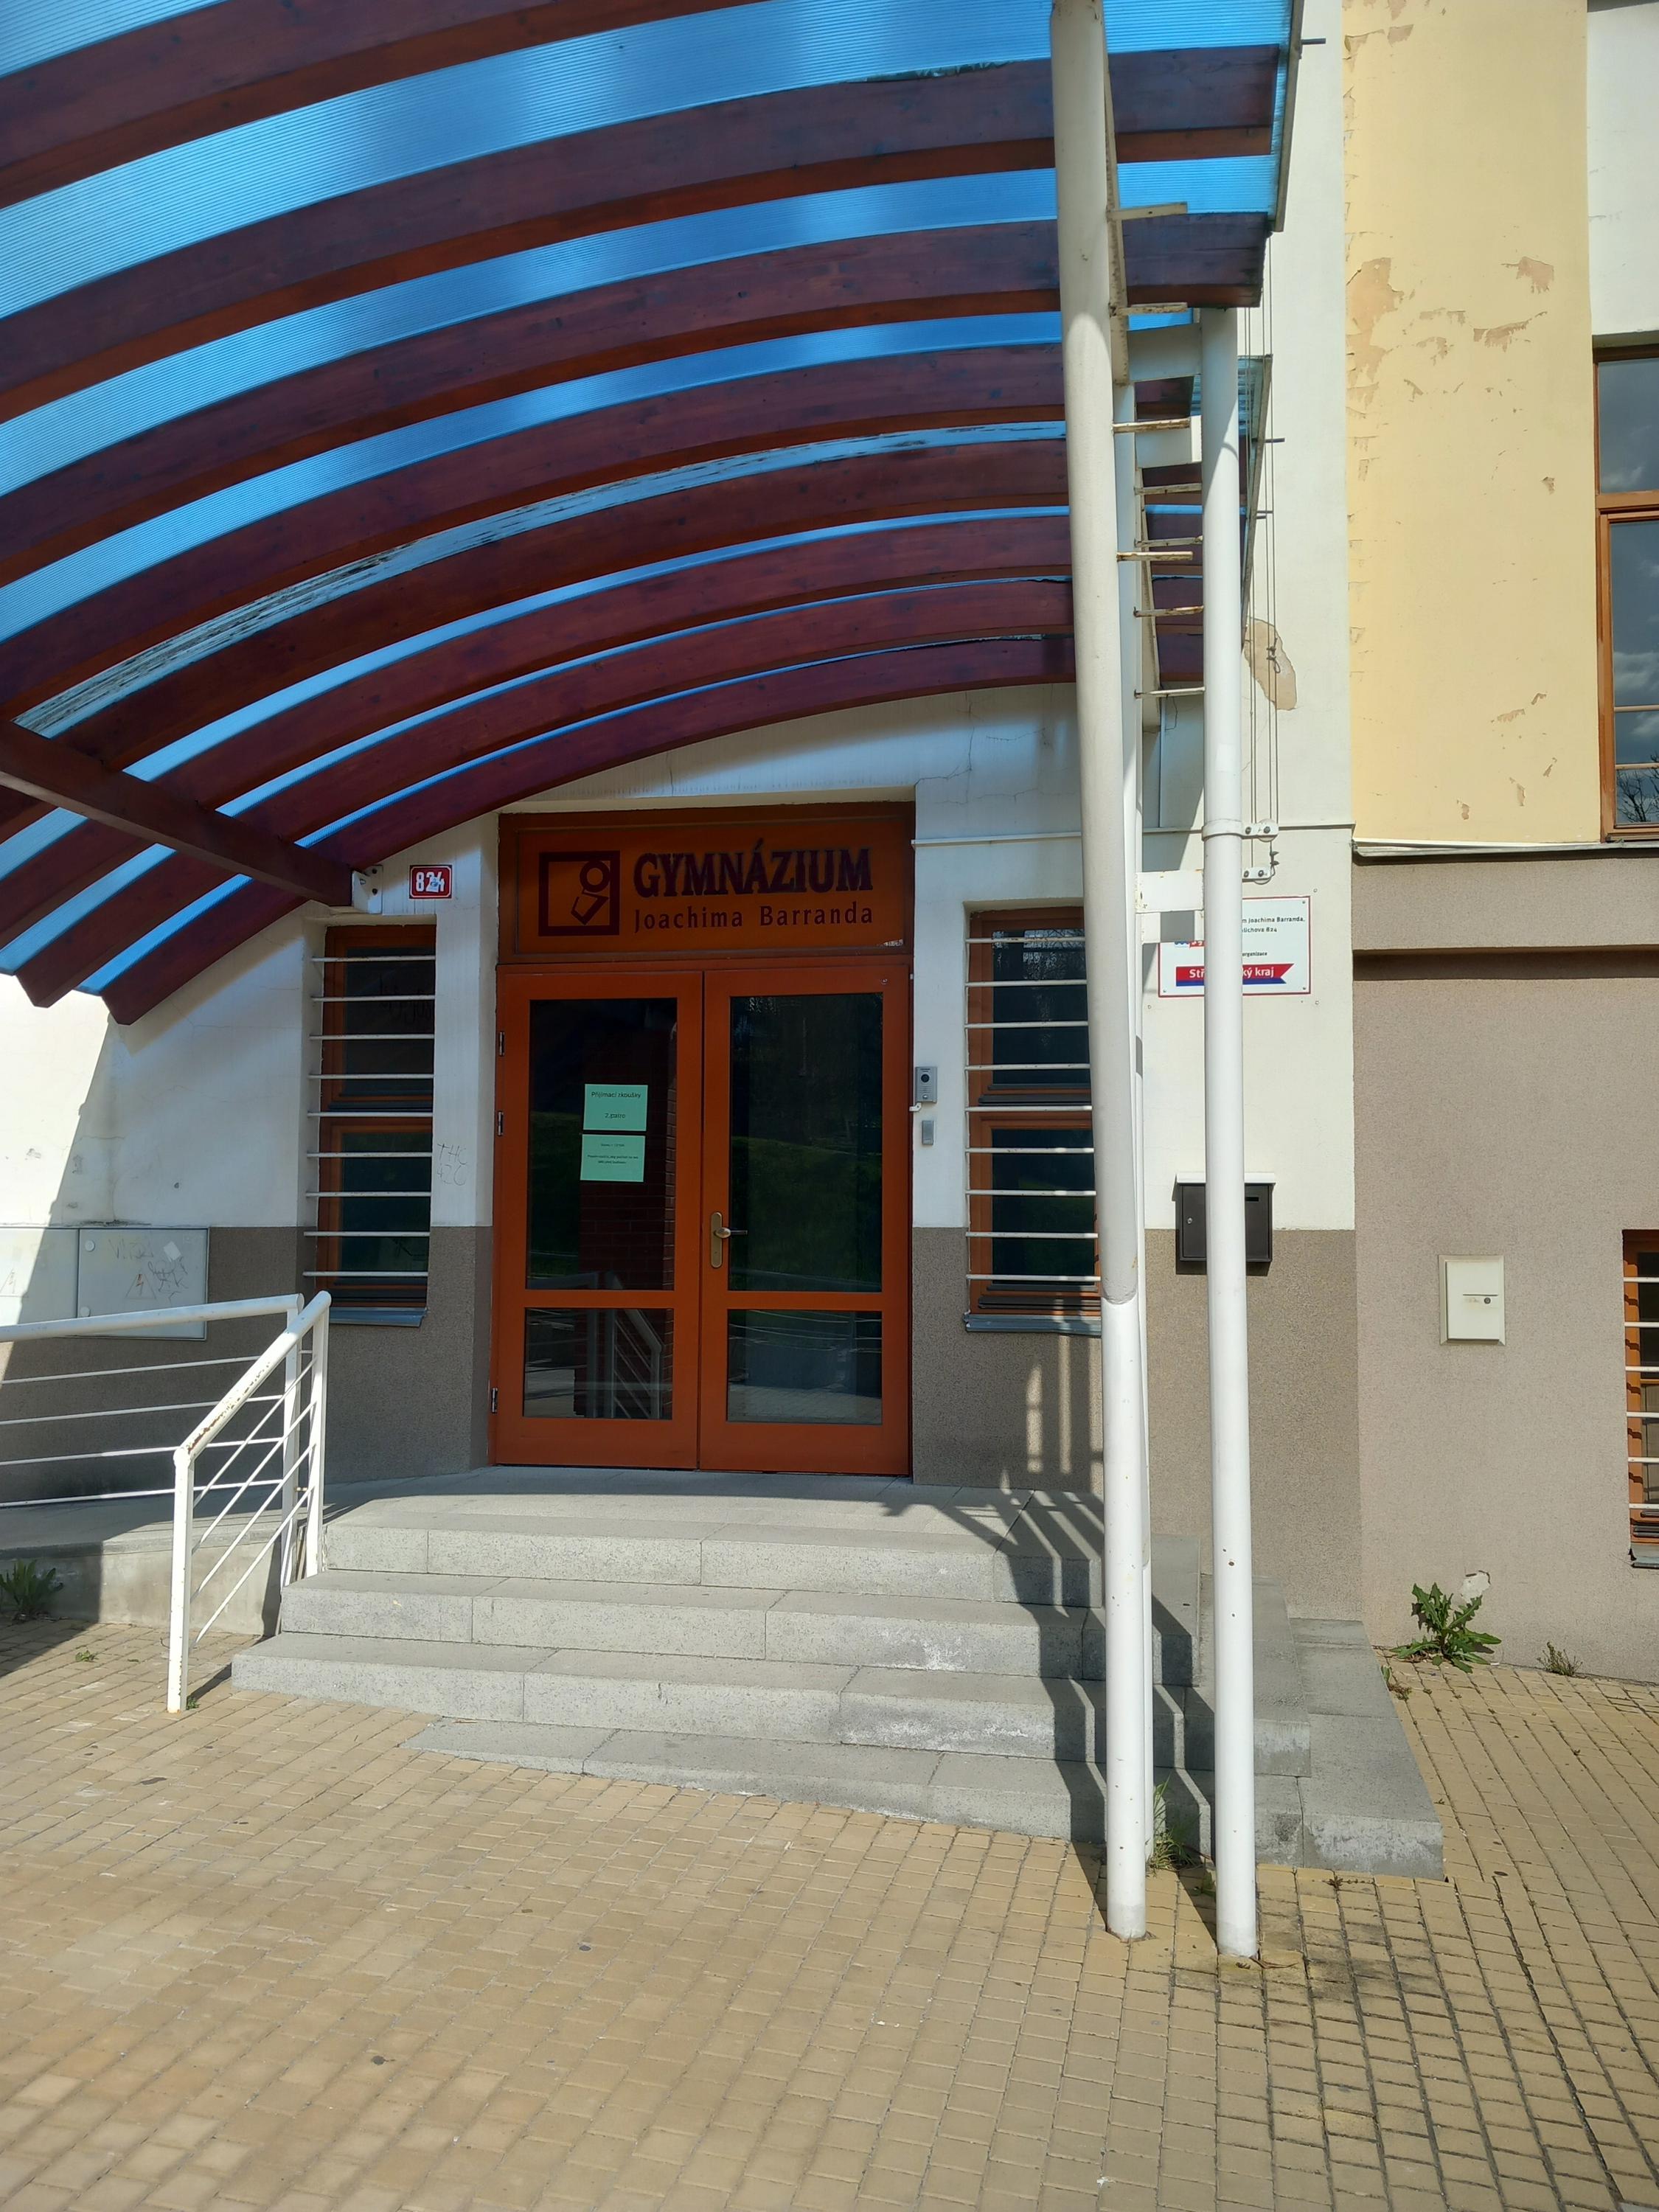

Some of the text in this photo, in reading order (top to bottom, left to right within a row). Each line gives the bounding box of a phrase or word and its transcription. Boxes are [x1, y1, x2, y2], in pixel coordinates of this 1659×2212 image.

[633, 838, 874, 898] GYMNÁZIUM
[416, 872, 445, 893] 824
[634, 901, 873, 933] Joachima Barranda
[1255, 967, 1274, 978] kraj
